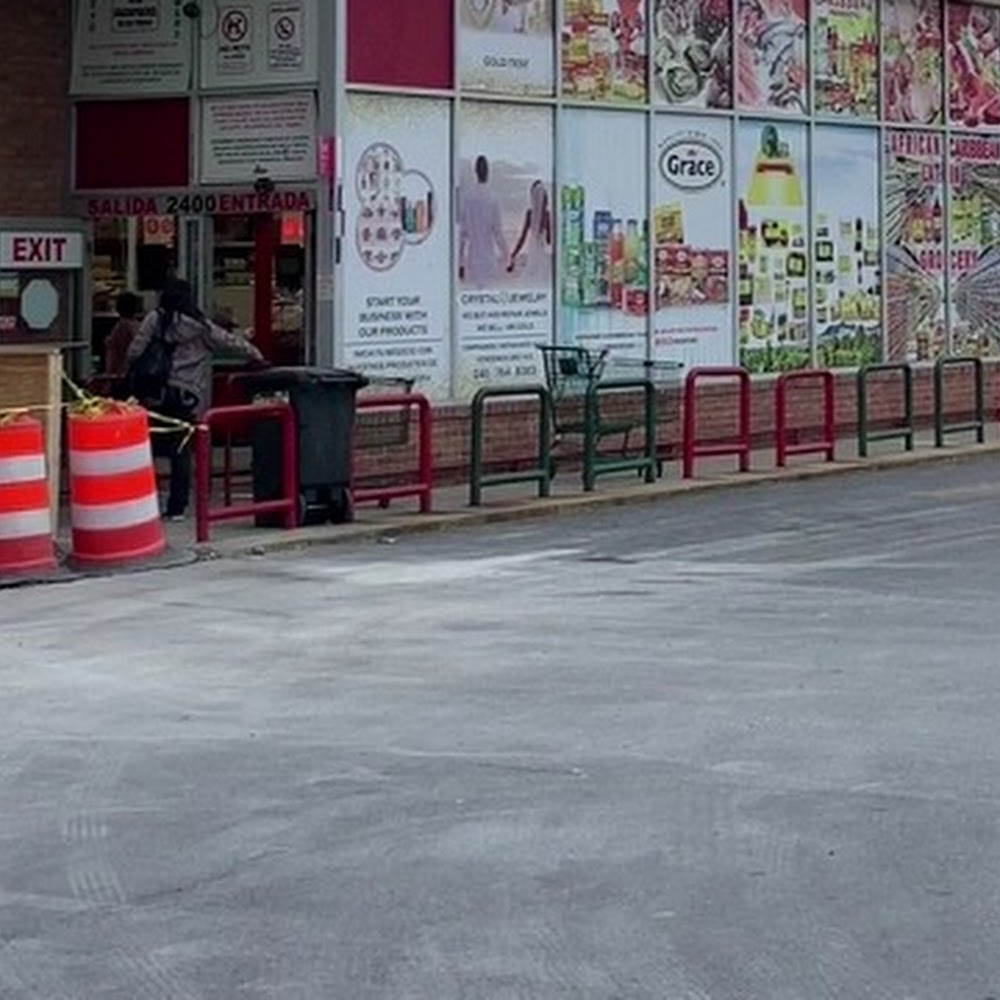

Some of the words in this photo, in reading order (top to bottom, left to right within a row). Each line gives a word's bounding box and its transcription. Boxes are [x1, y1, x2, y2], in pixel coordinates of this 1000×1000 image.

[890, 133, 940, 156] AFRICAN
[667, 154, 715, 178] Grace
[88, 199, 157, 216] SALIDA
[166, 196, 218, 214] 2400
[218, 191, 311, 214] ENTRADA
[13, 236, 68, 262] EXIT
[366, 296, 395, 308] START
[397, 295, 421, 307] YOUR
[358, 310, 403, 323] BUSINESS
[405, 309, 428, 320] WITH
[358, 326, 378, 338] OUR
[380, 323, 428, 337] PRODUCTS
